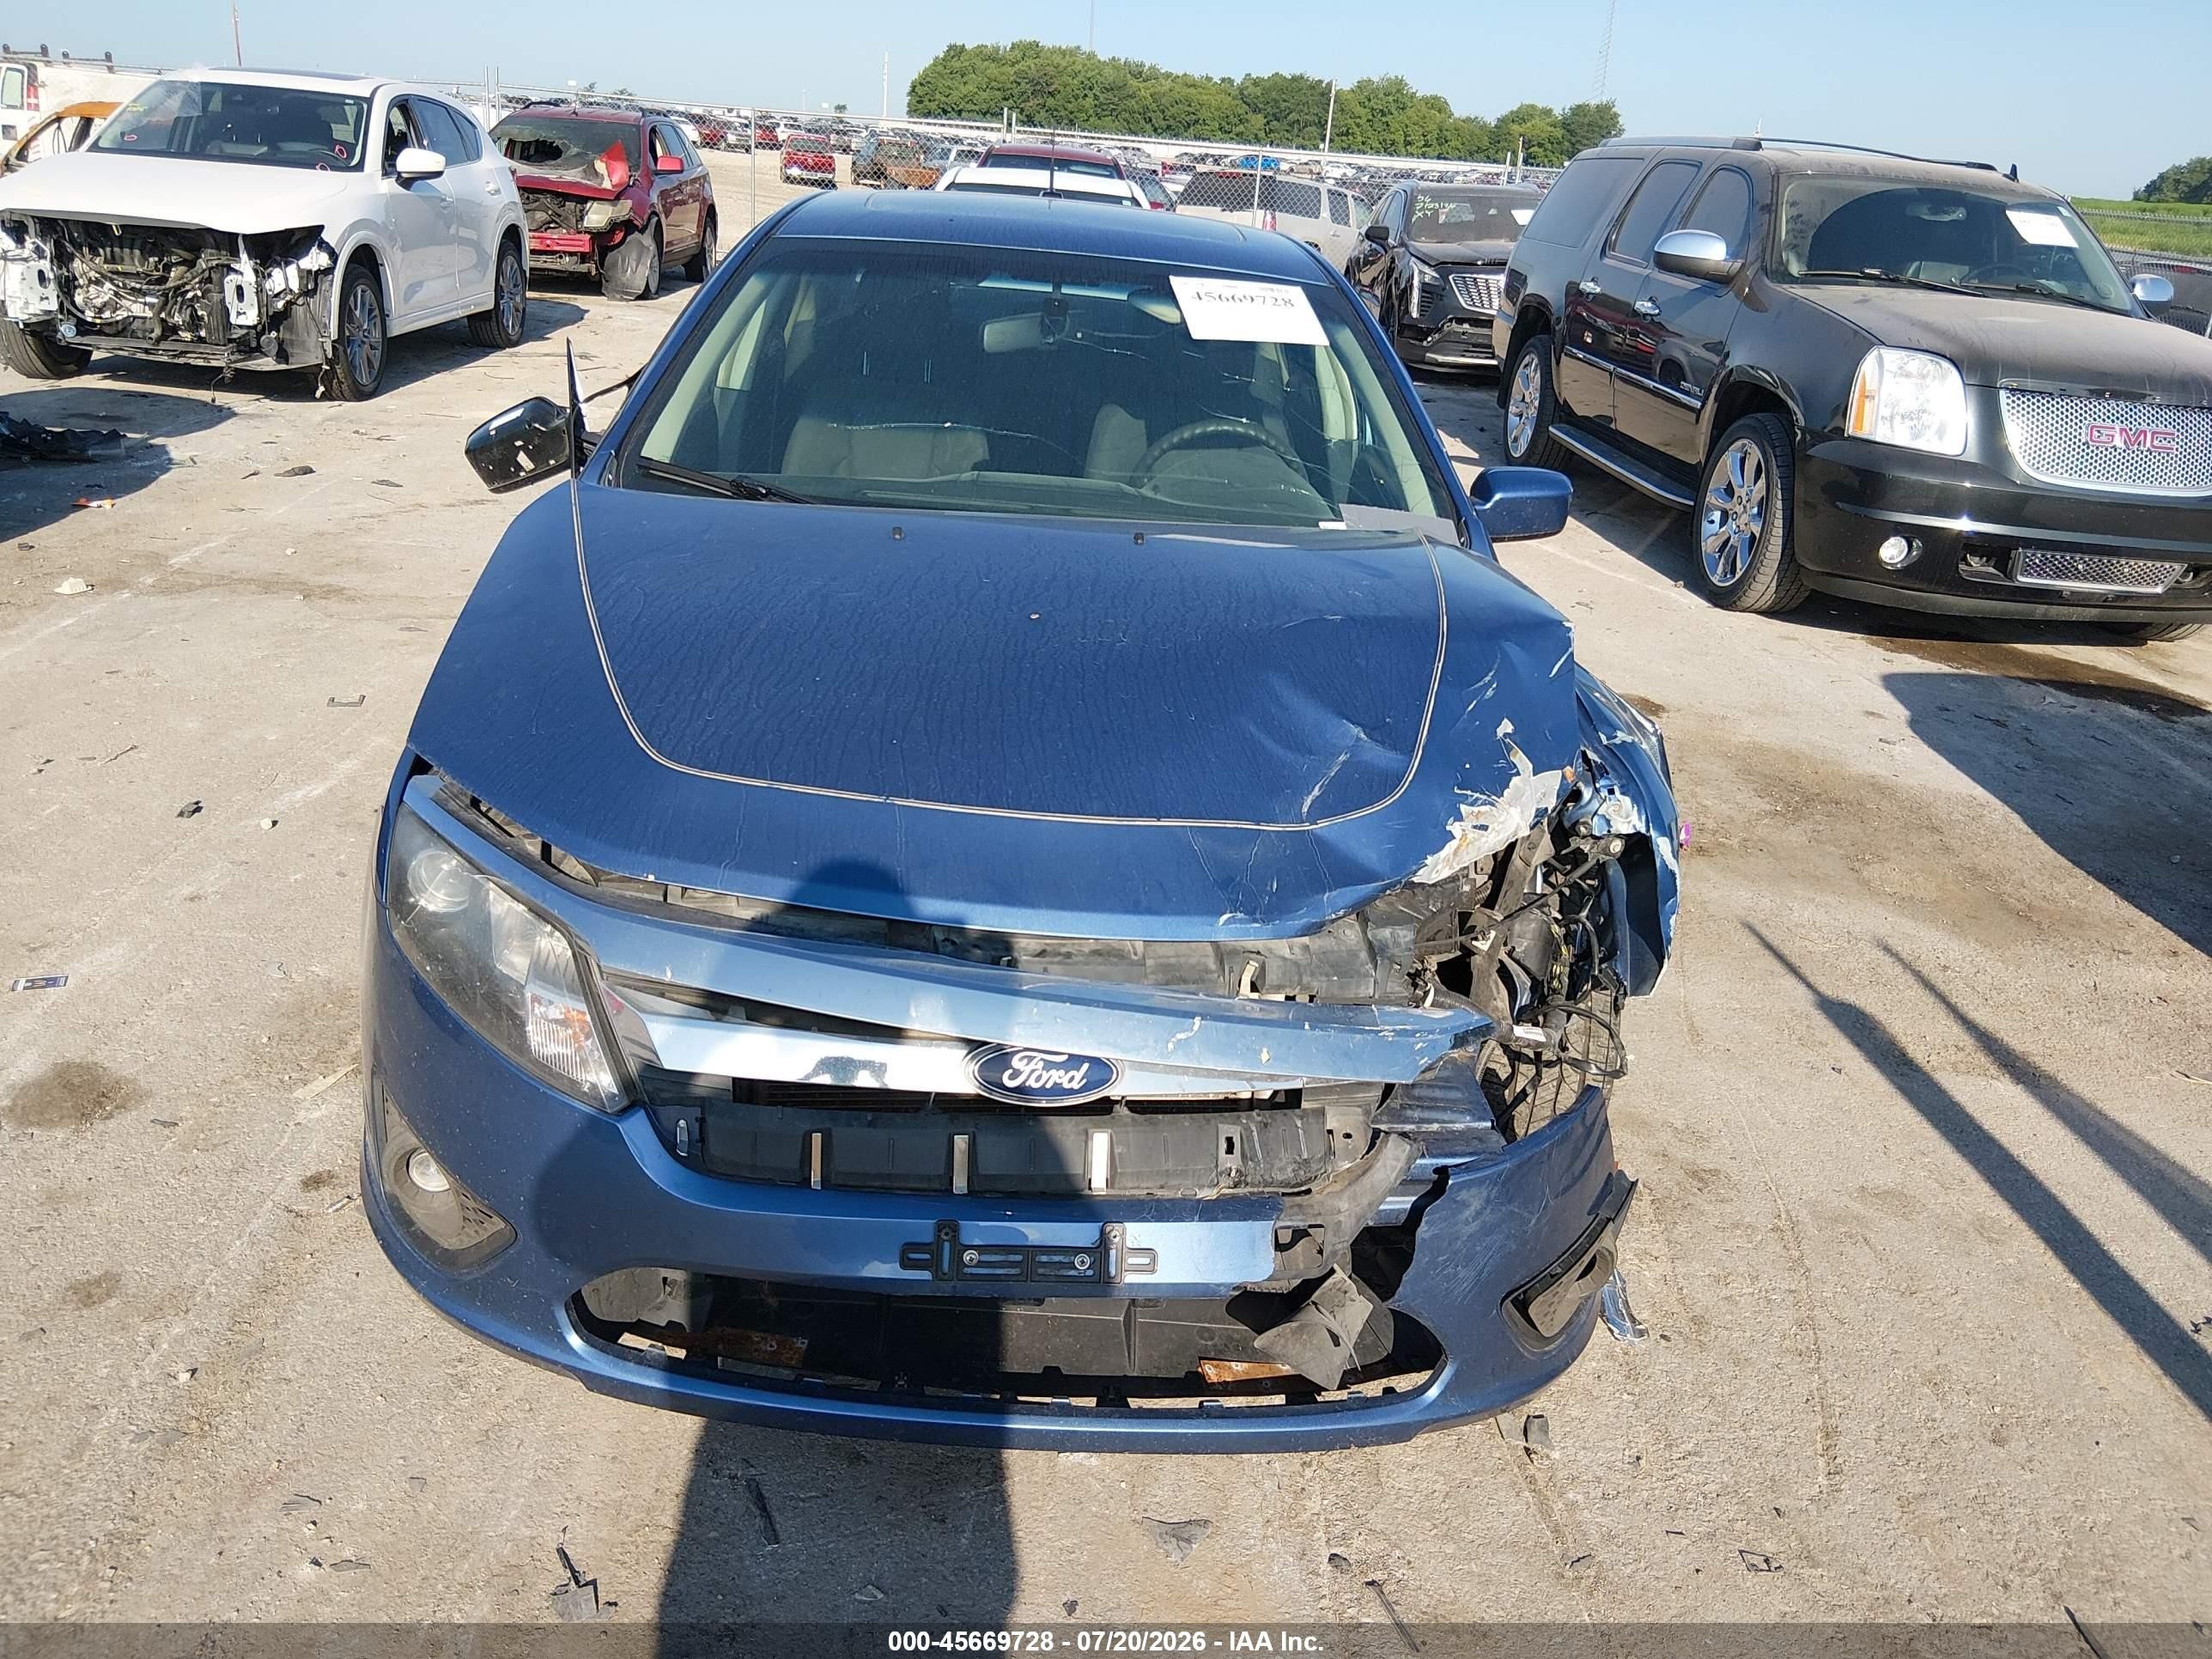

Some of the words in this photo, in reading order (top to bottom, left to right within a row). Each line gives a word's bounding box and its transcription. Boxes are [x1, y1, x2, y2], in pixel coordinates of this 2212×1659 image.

[1192, 291, 1295, 307] 45669728
[2087, 422, 2176, 453] GMC
[1002, 1051, 1090, 1090] Ford
